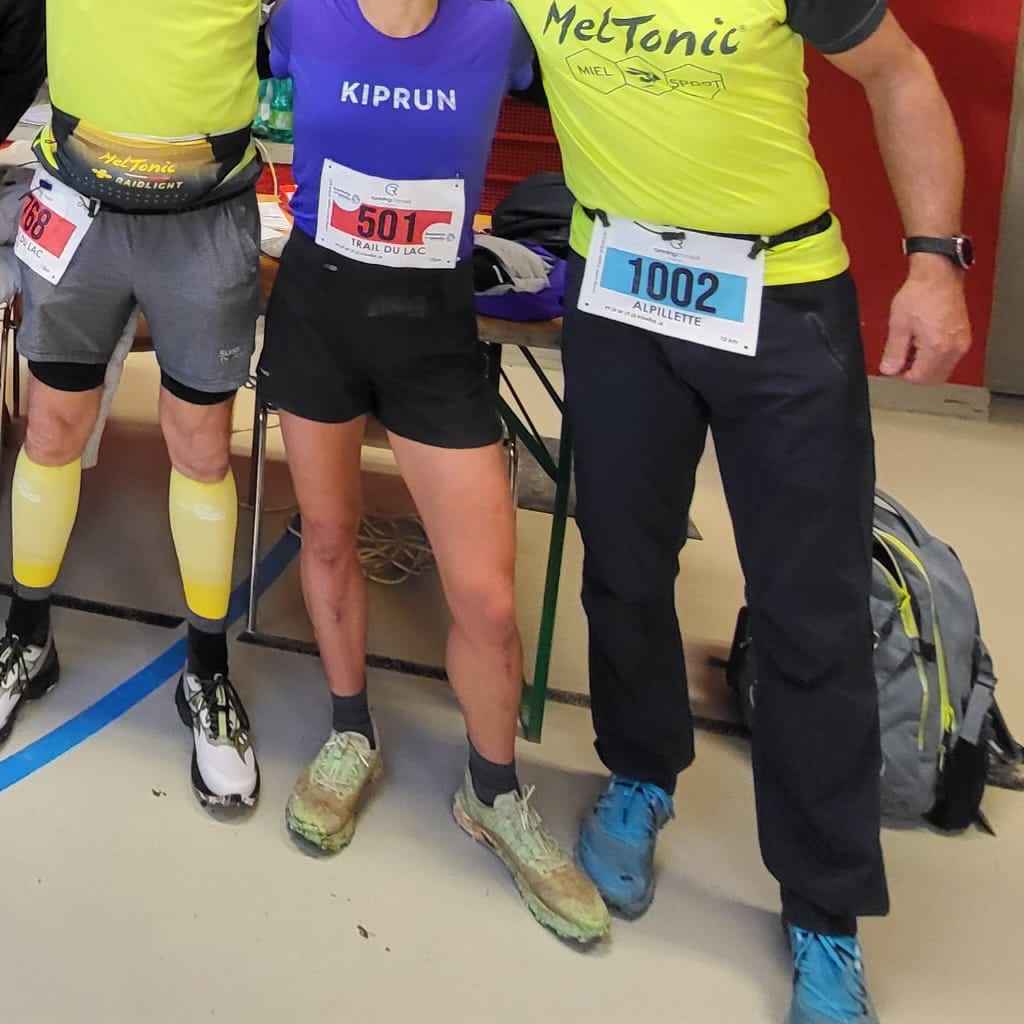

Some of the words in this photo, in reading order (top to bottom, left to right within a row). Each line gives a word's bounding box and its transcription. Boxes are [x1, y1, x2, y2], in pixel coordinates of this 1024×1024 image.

[542, 0, 741, 57] MelTonic
[576, 65, 612, 77] MIEL
[340, 80, 457, 112] KIPRUN
[97, 151, 176, 174] MelTonic
[114, 176, 185, 190] RAIDLIGHT
[356, 204, 417, 243] 501
[27, 242, 44, 258] LAC
[351, 237, 380, 253] TRAIL
[383, 244, 401, 255] DU
[403, 245, 426, 256] LAC
[628, 257, 720, 315] 1002
[632, 300, 703, 327] ALPILLETTE
